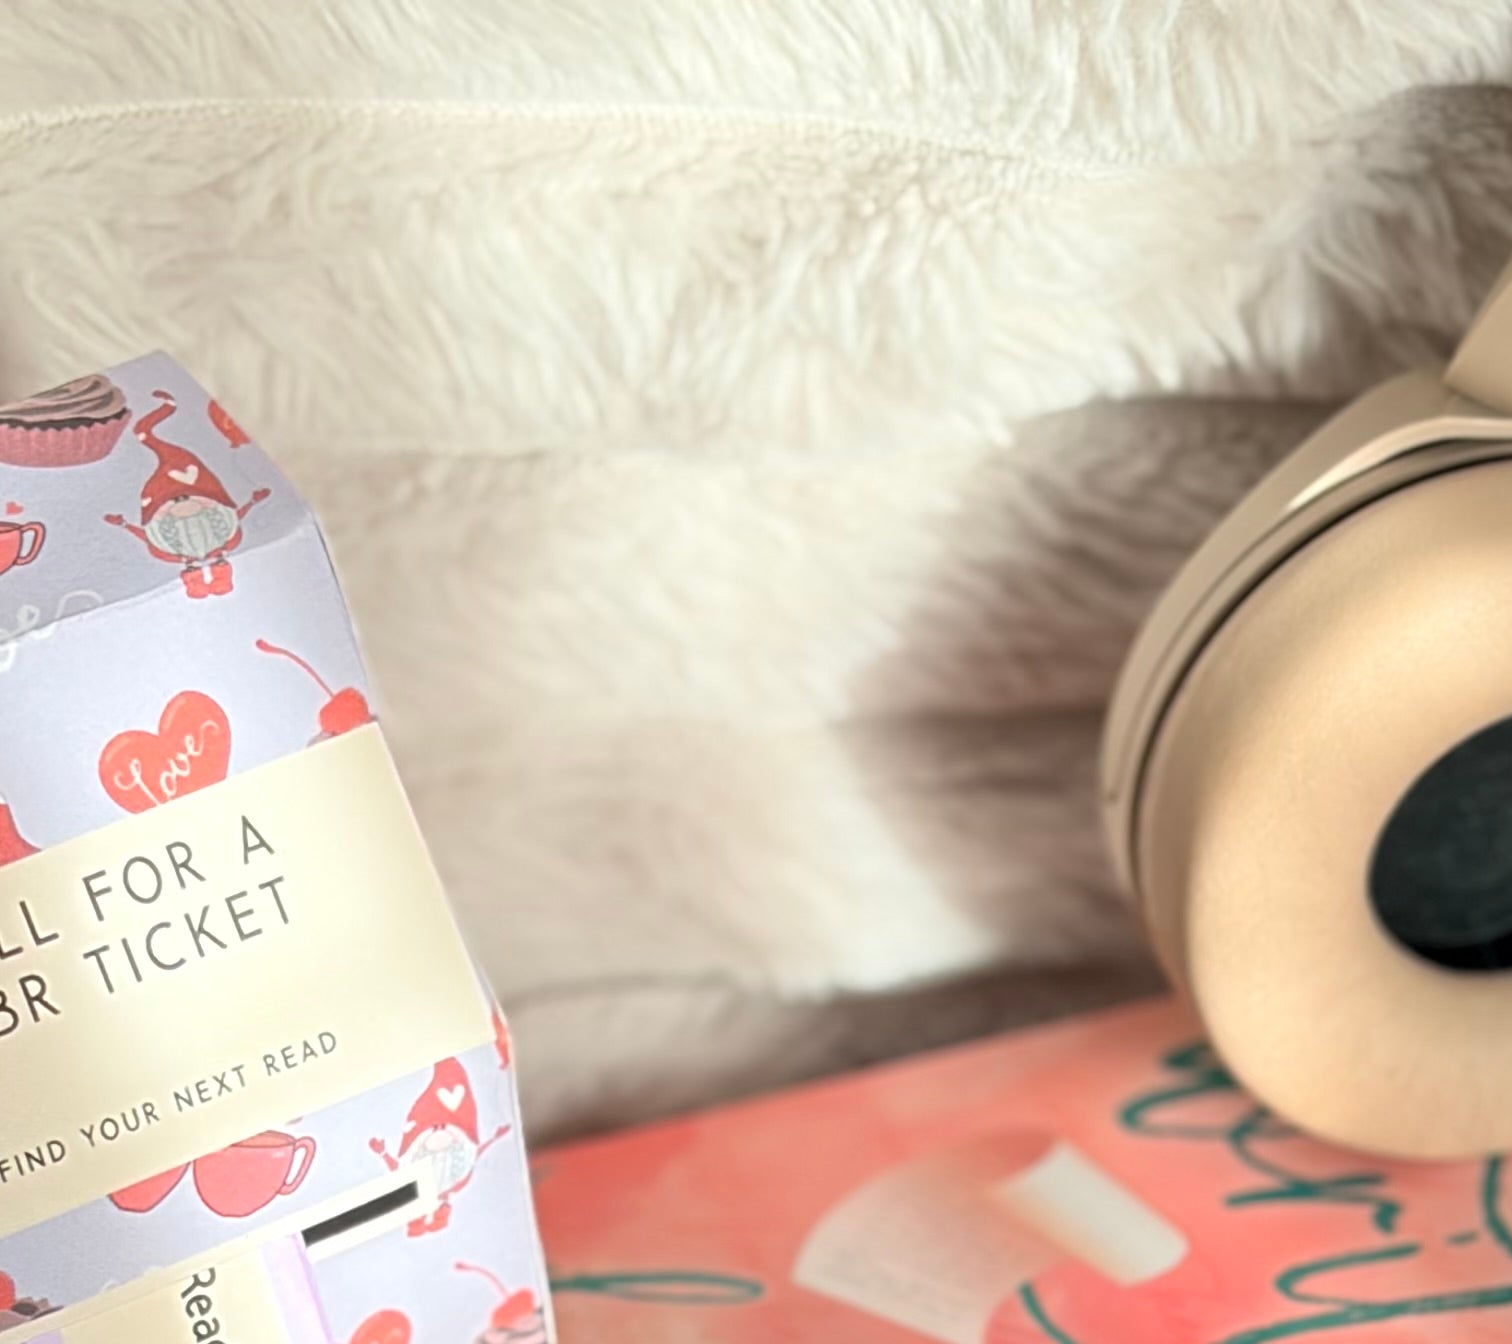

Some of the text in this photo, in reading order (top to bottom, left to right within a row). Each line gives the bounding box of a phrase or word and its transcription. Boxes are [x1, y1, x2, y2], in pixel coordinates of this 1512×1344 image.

[82, 840, 206, 922] FOR
[241, 815, 275, 865] A
[83, 876, 290, 994] TICKET
[0, 1031, 338, 1183] FIND YOUR NEXT READ
